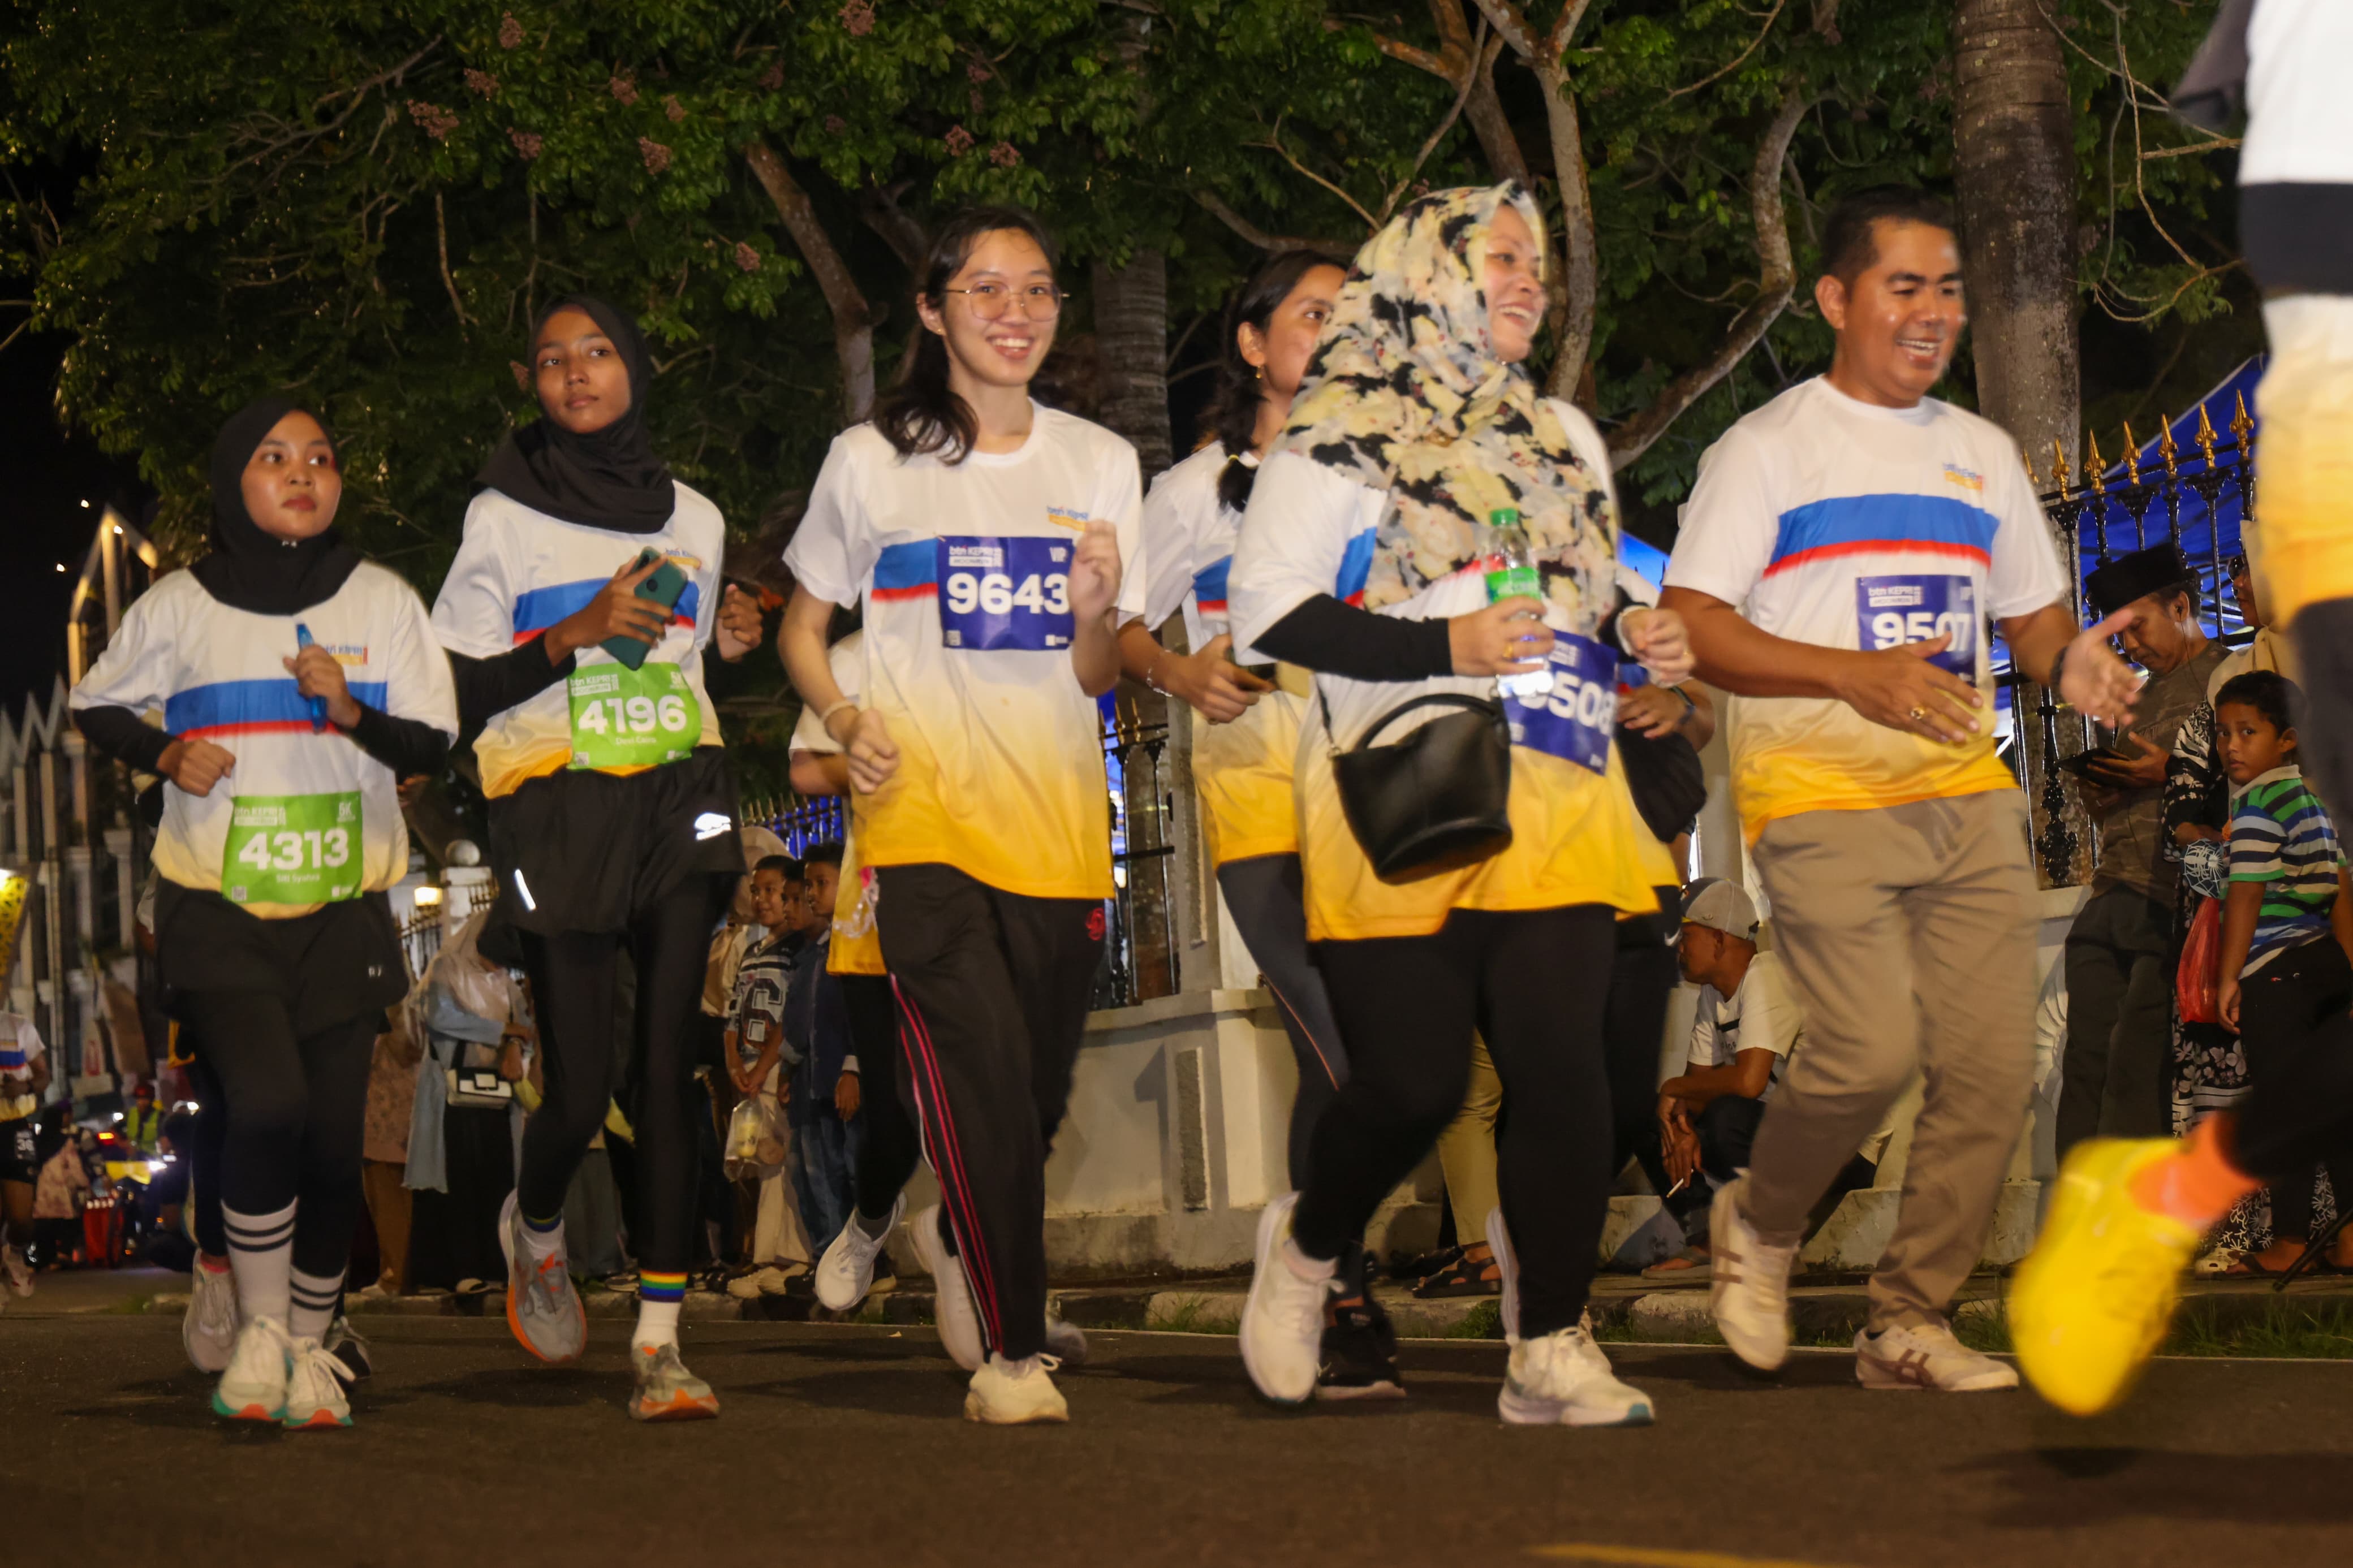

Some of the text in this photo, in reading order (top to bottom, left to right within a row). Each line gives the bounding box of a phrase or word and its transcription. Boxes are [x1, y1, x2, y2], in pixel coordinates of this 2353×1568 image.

[946, 572, 1071, 615] 9643
[1872, 612, 1973, 652] 9507
[578, 695, 687, 735] 4196
[1518, 671, 1617, 736] 508
[239, 827, 349, 870] 4313
